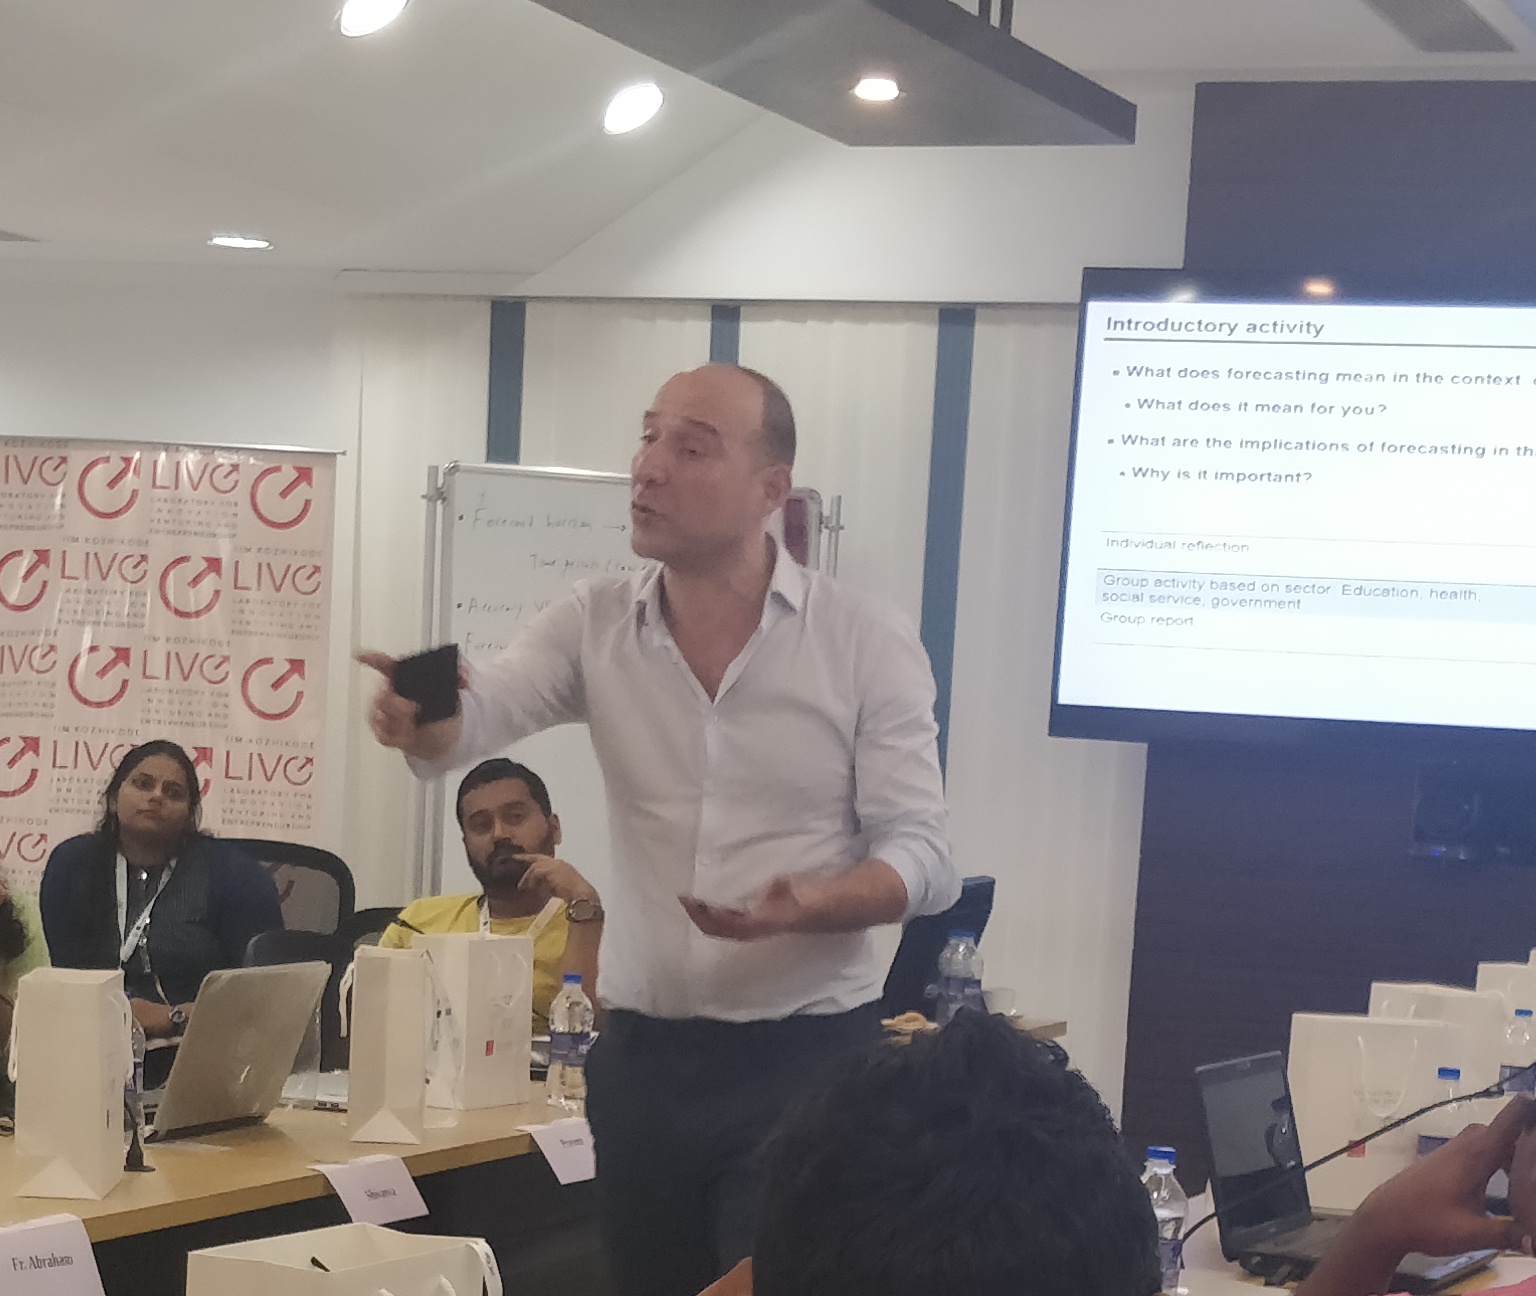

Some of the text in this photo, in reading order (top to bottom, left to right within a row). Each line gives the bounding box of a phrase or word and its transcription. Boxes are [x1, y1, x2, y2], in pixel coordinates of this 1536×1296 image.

[1106, 316, 1325, 338] Introductory activity
[1126, 365, 1172, 379] What
[1177, 367, 1220, 380] does
[1227, 367, 1330, 384] forecasting
[1335, 371, 1386, 383] mean
[1392, 371, 1409, 383] in
[1415, 372, 1444, 385] the
[1450, 374, 1521, 386] context
[1137, 398, 1387, 418] What does it mean for you?
[1121, 434, 1166, 447] What
[1172, 437, 1199, 448] are
[1205, 437, 1232, 449] the
[1239, 438, 1350, 452] implications
[1356, 441, 1374, 452] of
[1381, 442, 1486, 459] forecasting
[1493, 446, 1509, 457] in
[1131, 466, 1313, 484] Why is it important?
[1106, 537, 1176, 550] Individual
[1103, 574, 1149, 588] Group
[1153, 576, 1205, 592] activity
[1210, 579, 1256, 592] based
[1261, 582, 1280, 593] on
[1102, 591, 1144, 603] social
[1211, 596, 1301, 610] government
[1100, 611, 1194, 627] Group report
